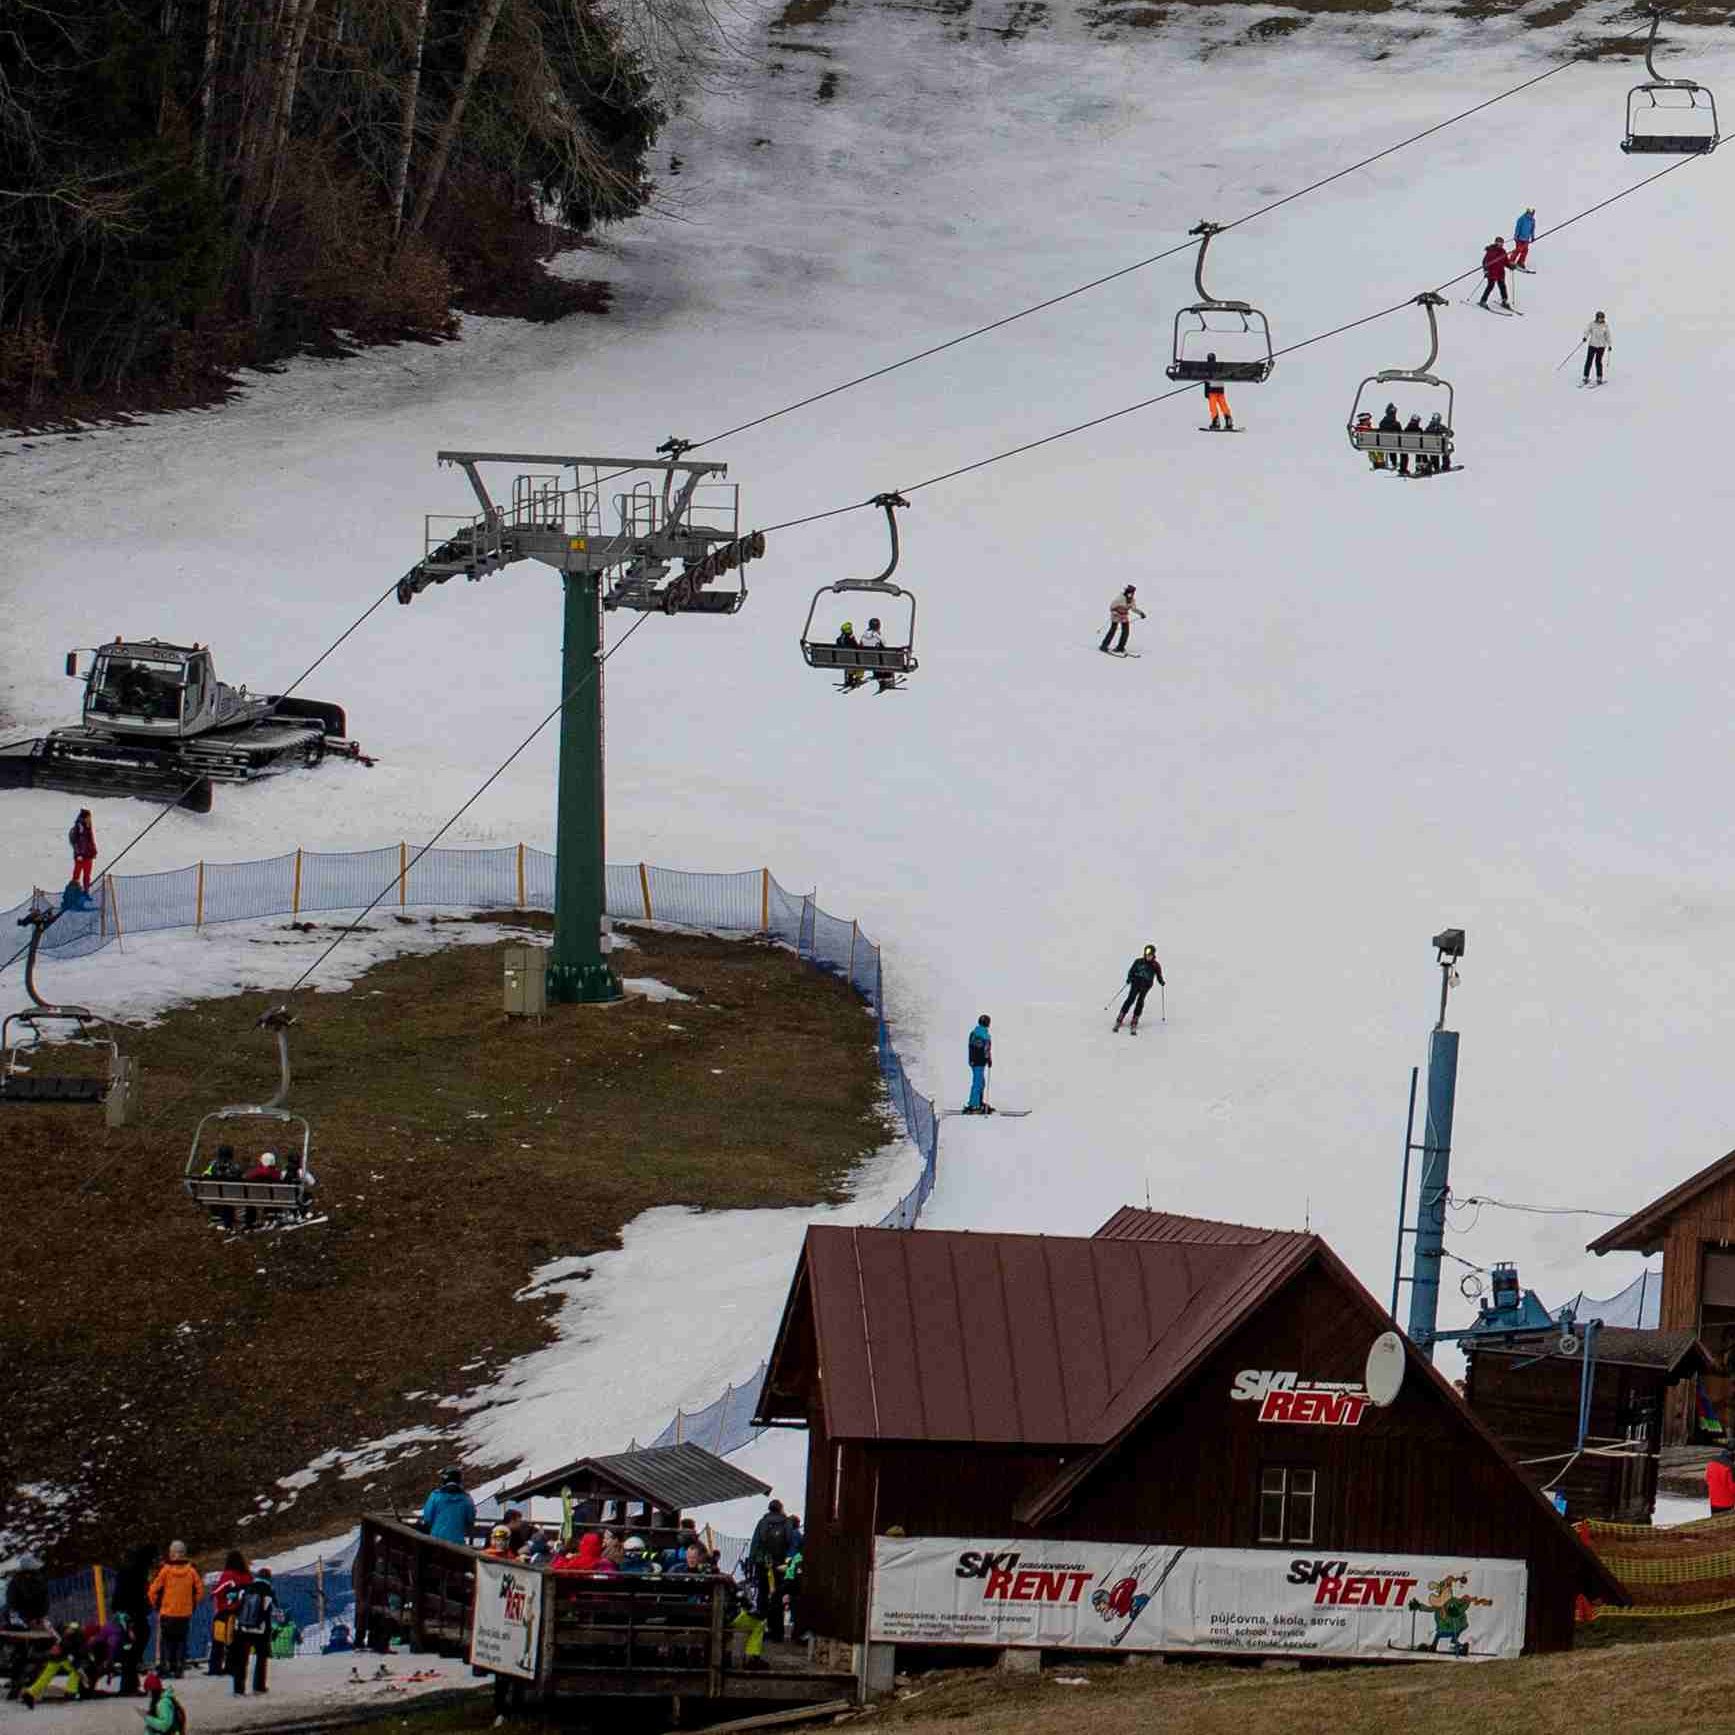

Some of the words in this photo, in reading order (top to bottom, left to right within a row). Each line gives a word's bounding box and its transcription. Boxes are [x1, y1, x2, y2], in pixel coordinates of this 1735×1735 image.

[1231, 1370, 1298, 1401] SKI
[1258, 1390, 1367, 1426] RENT
[955, 1552, 1022, 1578] SKI
[1287, 1559, 1349, 1584] SKI
[983, 1571, 1095, 1602] RENT
[1314, 1577, 1419, 1606] RENT
[1210, 1612, 1269, 1627] půjčovna,
[1272, 1613, 1307, 1627] škola,
[1310, 1616, 1347, 1627] servis
